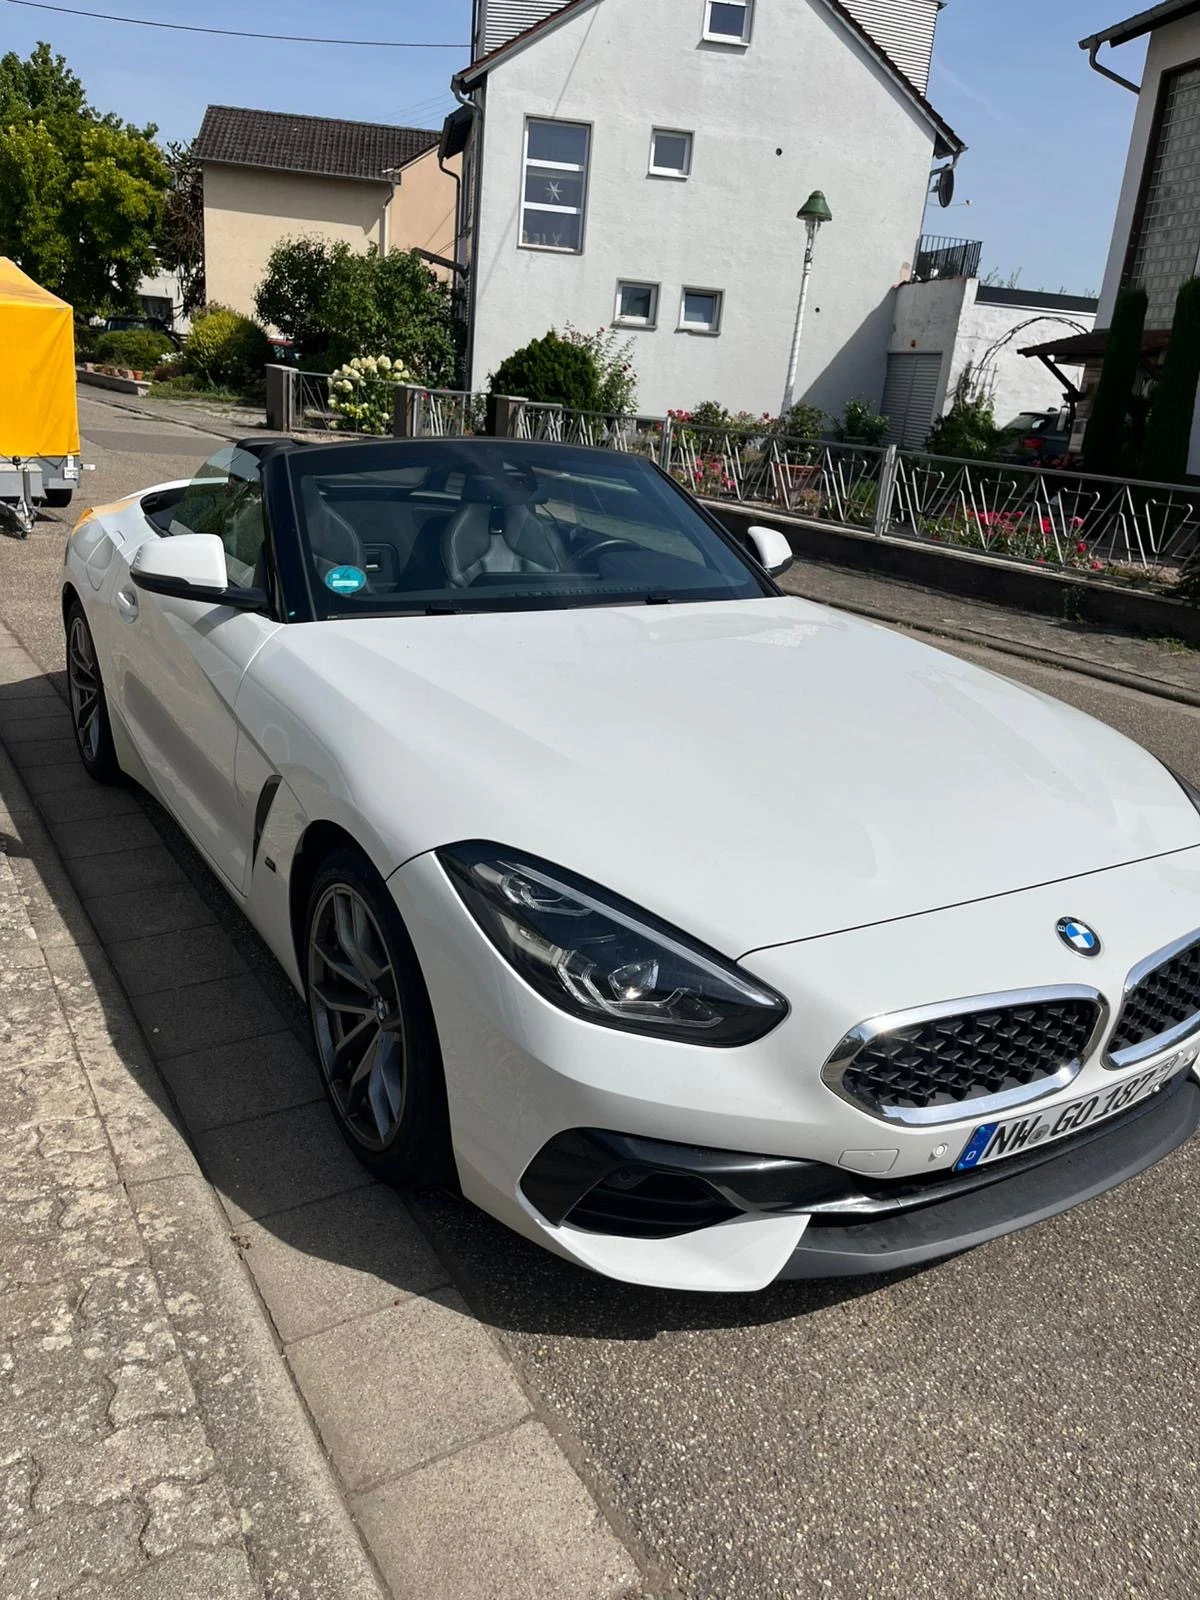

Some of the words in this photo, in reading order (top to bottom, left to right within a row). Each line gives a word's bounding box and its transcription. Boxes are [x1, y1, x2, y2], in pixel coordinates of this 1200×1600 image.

[982, 1114, 1043, 1159] NW
[1049, 1095, 1100, 1137] GO
[1092, 1067, 1158, 1119] 187
[965, 1150, 977, 1161] D
